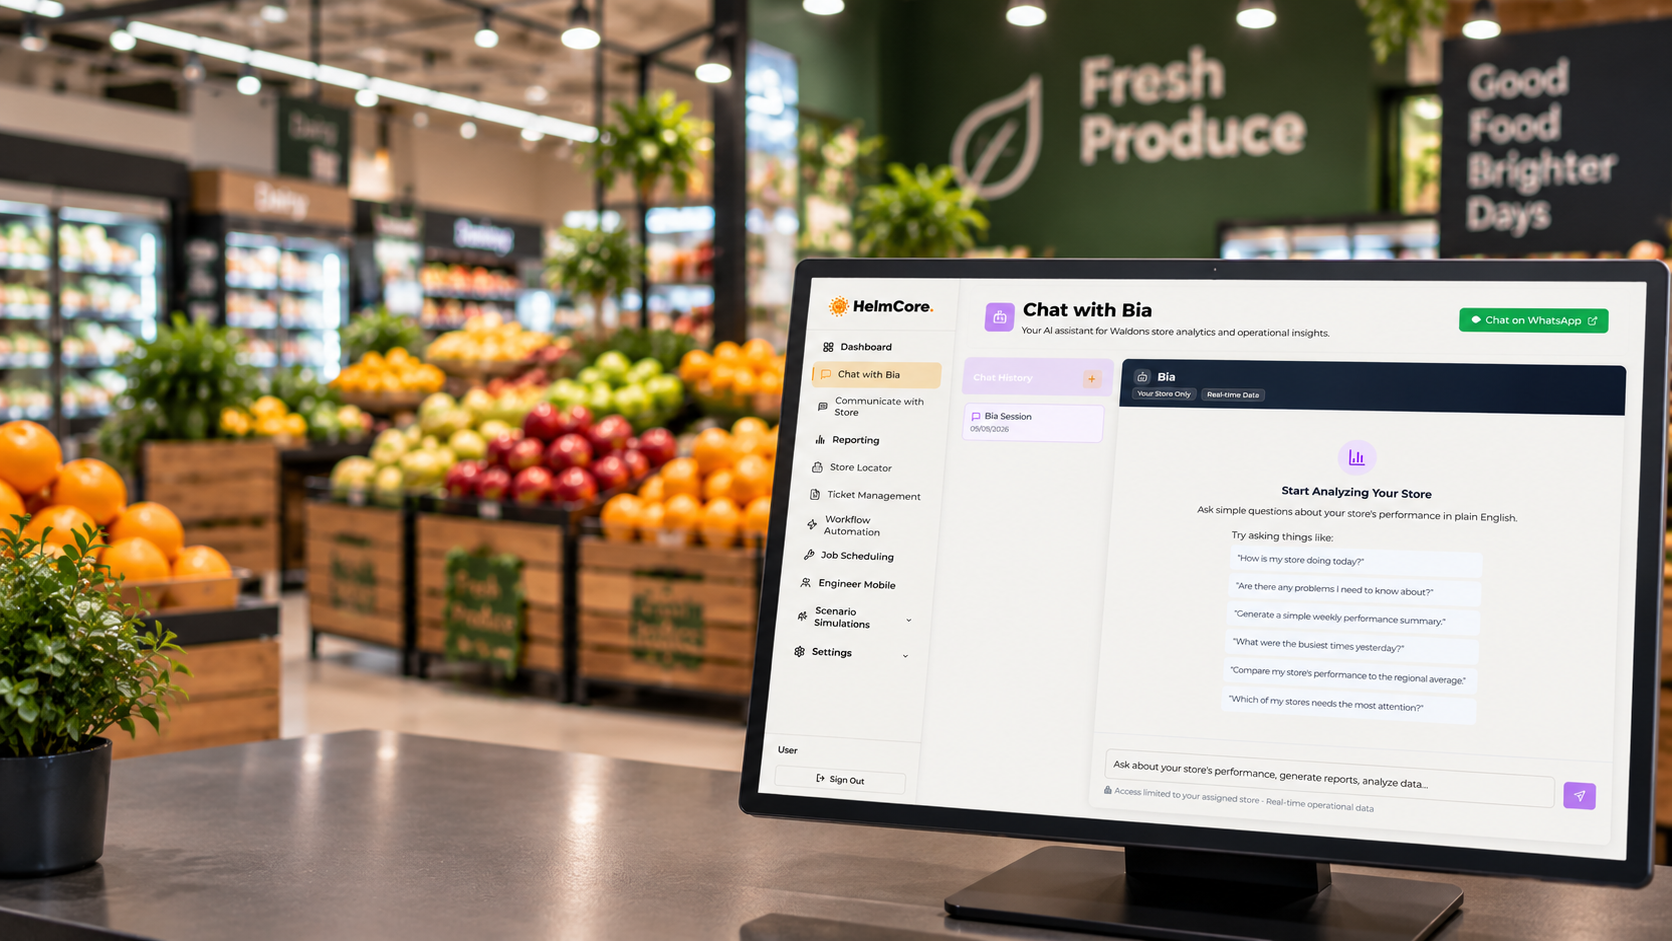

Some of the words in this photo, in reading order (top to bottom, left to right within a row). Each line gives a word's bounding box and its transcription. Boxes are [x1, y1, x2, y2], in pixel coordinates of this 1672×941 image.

[1080, 45, 1226, 109] Fresh
[1467, 56, 1571, 101] Good
[1467, 101, 1562, 147] Food
[1080, 104, 1308, 166] Produce
[1466, 147, 1620, 197] Brighter
[1466, 194, 1552, 238] Days
[853, 299, 934, 312] HelmCore.
[1023, 302, 1068, 317] Chat
[1073, 301, 1116, 317] with
[1122, 301, 1152, 318] Bia
[1485, 315, 1510, 325] Chat
[1527, 316, 1582, 326] WhatsApp
[1021, 326, 1042, 335] Your
[1043, 326, 1053, 334] AI
[1054, 326, 1094, 335] assistant
[1095, 326, 1108, 336] for
[1109, 327, 1150, 336] Waldons
[1175, 328, 1216, 338] analytics
[1217, 328, 1236, 337] and
[1237, 328, 1290, 338] operational
[1291, 328, 1330, 339] insights.
[840, 342, 892, 352] Dashboard
[838, 369, 860, 379] Chat
[862, 370, 883, 379] with
[885, 370, 900, 379] Bia
[973, 373, 996, 382] Chat
[998, 373, 1034, 384] History
[1158, 372, 1176, 382] Bia
[835, 396, 902, 406] Communicate
[903, 397, 924, 406] with
[834, 408, 859, 417] Store
[984, 412, 999, 420] Bia
[1000, 412, 1032, 421] Session
[832, 435, 880, 447] Reporting
[830, 462, 855, 472] Store
[857, 463, 892, 473] Locator
[827, 490, 856, 499] Ticket
[857, 491, 921, 502] Management
[1281, 486, 1310, 496] Start
[1311, 487, 1369, 500] Analyzing
[1372, 488, 1399, 498] Your
[1401, 489, 1432, 499] Store
[825, 515, 871, 524] Workflow
[1196, 505, 1214, 514] Ask
[1215, 506, 1247, 516] simple
[1248, 507, 1293, 516] questions
[1294, 508, 1322, 517] about
[1323, 510, 1346, 519] your
[1347, 510, 1377, 518] store's
[1378, 510, 1441, 520] performance
[1443, 511, 1452, 520] in
[1454, 512, 1478, 522] plain
[1480, 512, 1518, 524] English.
[823, 526, 880, 537] Automation
[1231, 530, 1247, 541] Try
[1248, 531, 1280, 543] asking
[1282, 532, 1313, 544] things
[1314, 533, 1334, 542] like:
[820, 550, 839, 560] Job
[840, 551, 894, 564] Scheduling
[1237, 554, 1260, 562] "How
[1260, 554, 1268, 563] is
[1269, 556, 1284, 565] my
[1284, 556, 1306, 564] store
[1306, 556, 1332, 567] doing
[1332, 557, 1365, 568] today?"
[818, 578, 862, 590] Engineer
[864, 580, 896, 590] Mobile
[1236, 582, 1253, 590] "Are
[1254, 582, 1277, 591] there
[1277, 584, 1294, 593] any
[1294, 584, 1335, 593] problems
[1340, 586, 1363, 594] need
[1374, 587, 1400, 595] know
[1400, 587, 1434, 596] about?"
[815, 606, 857, 616] Scenario
[814, 618, 870, 629] Simulations
[1234, 609, 1275, 619] "Generate
[1282, 611, 1312, 621] simple
[1312, 613, 1343, 623] weekly
[1343, 614, 1399, 624] performance
[1399, 617, 1446, 628] summary."
[1232, 637, 1259, 647] "What
[1282, 640, 1297, 648] the
[1298, 640, 1328, 650] busiest
[1330, 641, 1355, 651] times
[1355, 644, 1405, 654] yesterday?"
[812, 647, 852, 659] Settings
[1230, 666, 1271, 676] "Compare
[1271, 669, 1286, 678] my
[1286, 669, 1313, 677] store's
[1313, 669, 1368, 680] performance
[1378, 673, 1393, 682] the
[1394, 674, 1428, 684] regional
[1428, 676, 1466, 686] average."
[1228, 694, 1259, 704] "Which
[1259, 696, 1270, 704] of
[1270, 698, 1284, 707] my
[1285, 698, 1310, 707] stores
[1311, 700, 1338, 708] needs
[1338, 700, 1353, 709] the
[1377, 703, 1424, 712] attention?"
[778, 745, 798, 754] User
[829, 775, 848, 785] Sign
[849, 777, 865, 785] Out
[1113, 760, 1130, 769] Ask
[1131, 761, 1159, 771] about
[1160, 765, 1182, 773] your
[1183, 766, 1213, 775] store's
[1214, 767, 1278, 780] performance,
[1279, 772, 1322, 782] generate
[1324, 775, 1360, 786] reports,
[1362, 777, 1399, 788] analyze
[1400, 779, 1428, 789] data...
[1114, 787, 1142, 796] Access
[1143, 788, 1171, 798] limited
[1201, 793, 1238, 804] assigned
[1239, 796, 1260, 804] store
[1266, 797, 1306, 808] Real-time
[1307, 802, 1354, 811] operational
[1355, 804, 1375, 813] data
